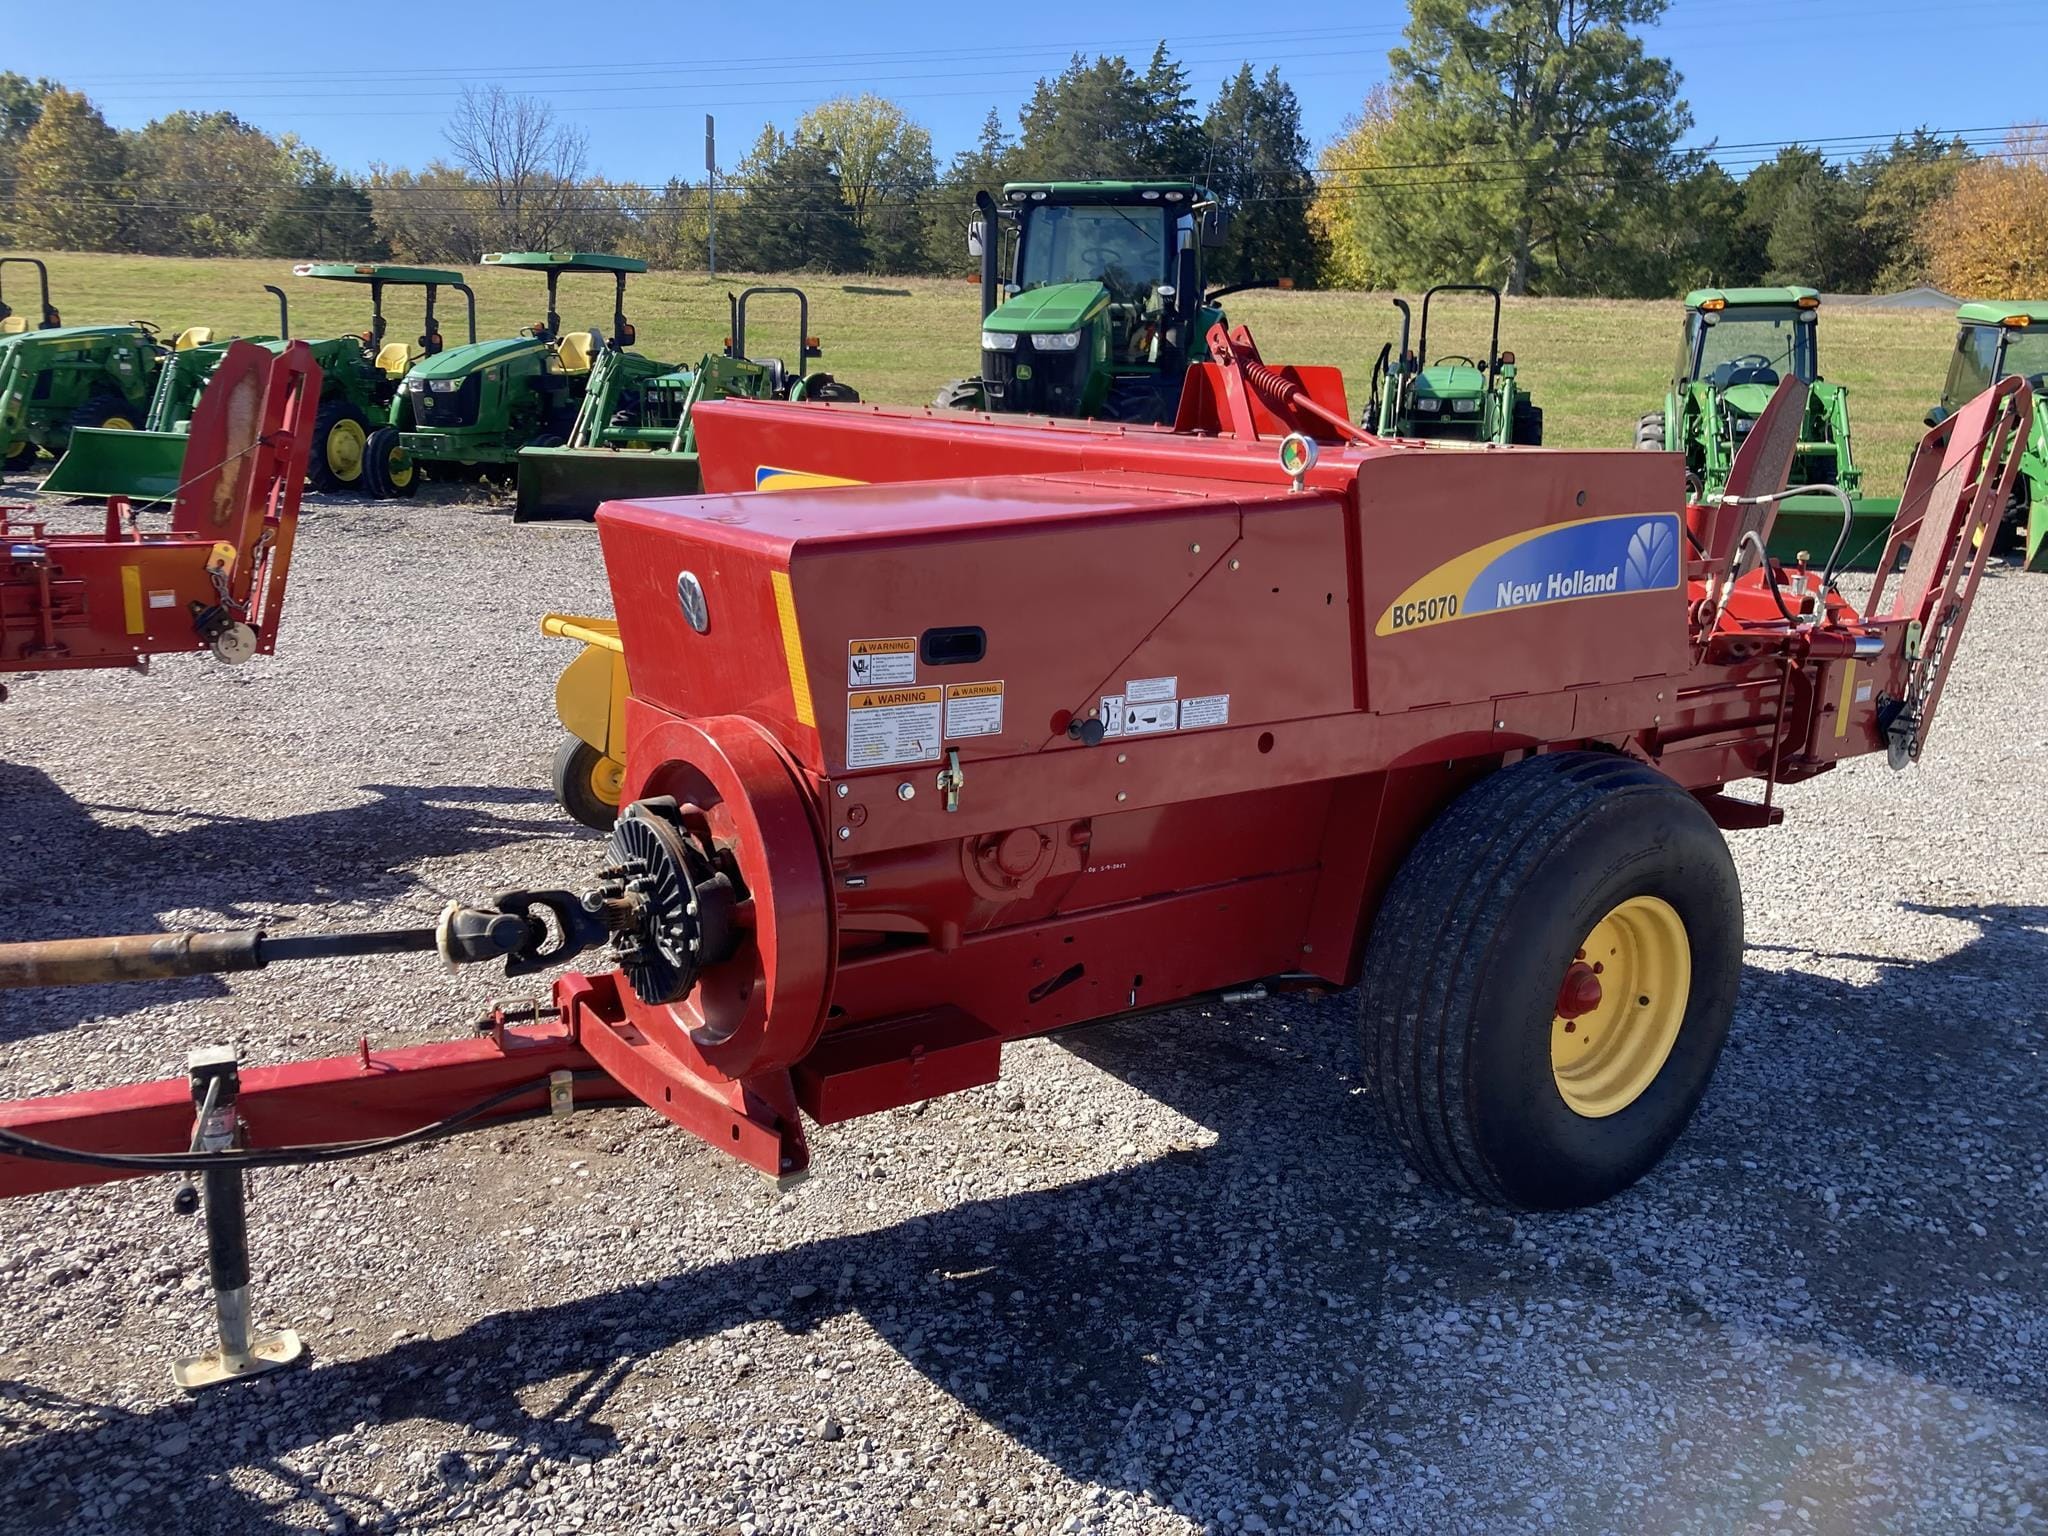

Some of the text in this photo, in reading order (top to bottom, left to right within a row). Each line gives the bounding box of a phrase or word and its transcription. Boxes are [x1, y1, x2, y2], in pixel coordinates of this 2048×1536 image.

[1496, 566, 1618, 609] New Holland
[1391, 594, 1458, 629] BC5070
[869, 642, 910, 651] WARNING
[961, 686, 997, 695] WARNING
[878, 692, 926, 704] WARNING
